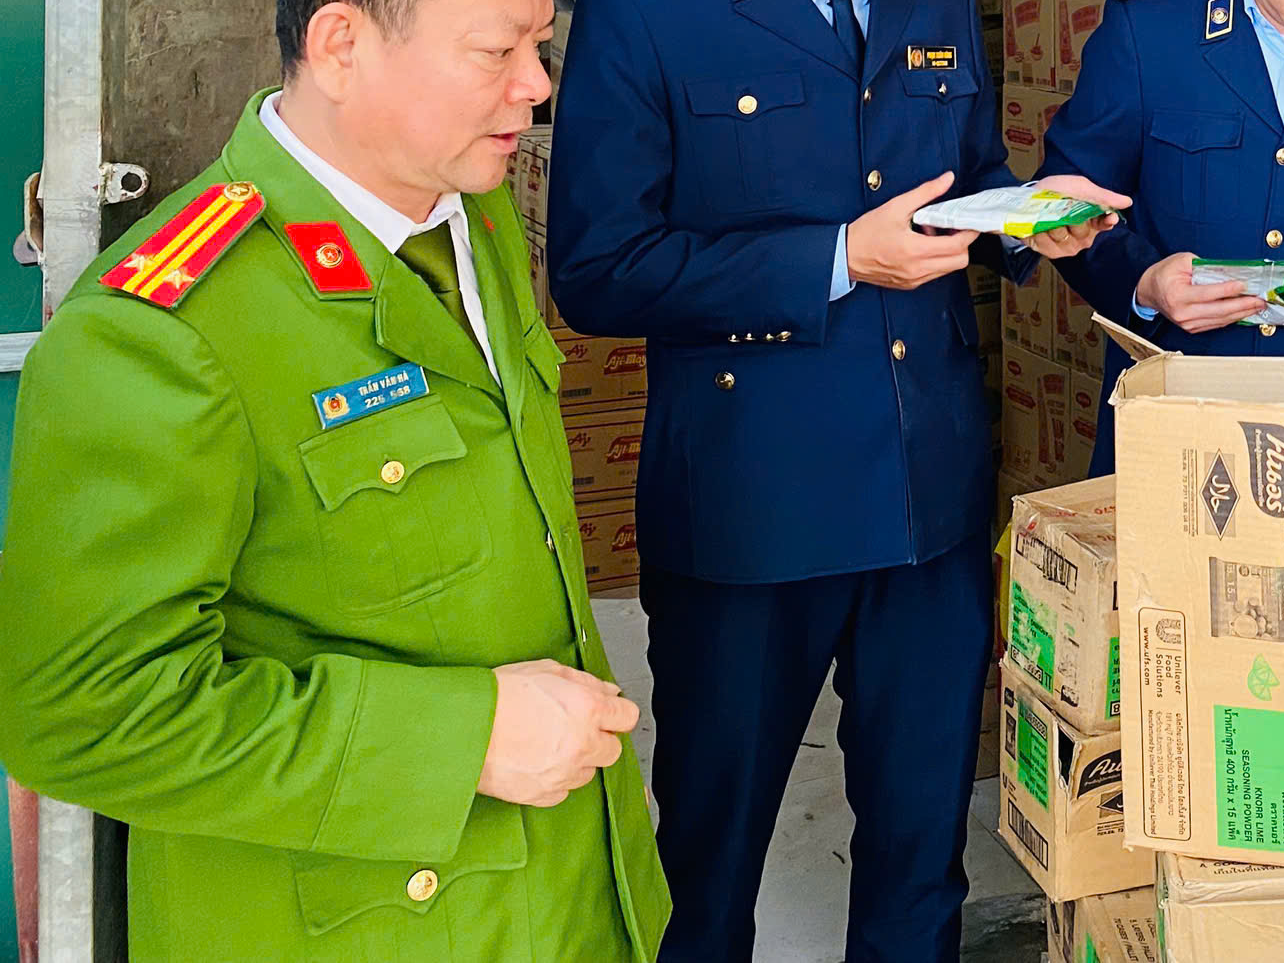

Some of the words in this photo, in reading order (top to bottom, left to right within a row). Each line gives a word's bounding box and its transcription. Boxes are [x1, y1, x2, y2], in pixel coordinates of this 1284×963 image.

[1143, 627, 1151, 686] www.ufs.com
[1165, 655, 1173, 678] Food
[1156, 653, 1164, 698] Solutions
[1174, 656, 1182, 695] Unilever
[1226, 759, 1235, 774] 400
[1242, 749, 1251, 800] SEASONING
[1228, 807, 1236, 817] 15
[1255, 787, 1263, 819] KNORR
[1244, 804, 1252, 842] POWDER
[1256, 822, 1264, 843] LIME
